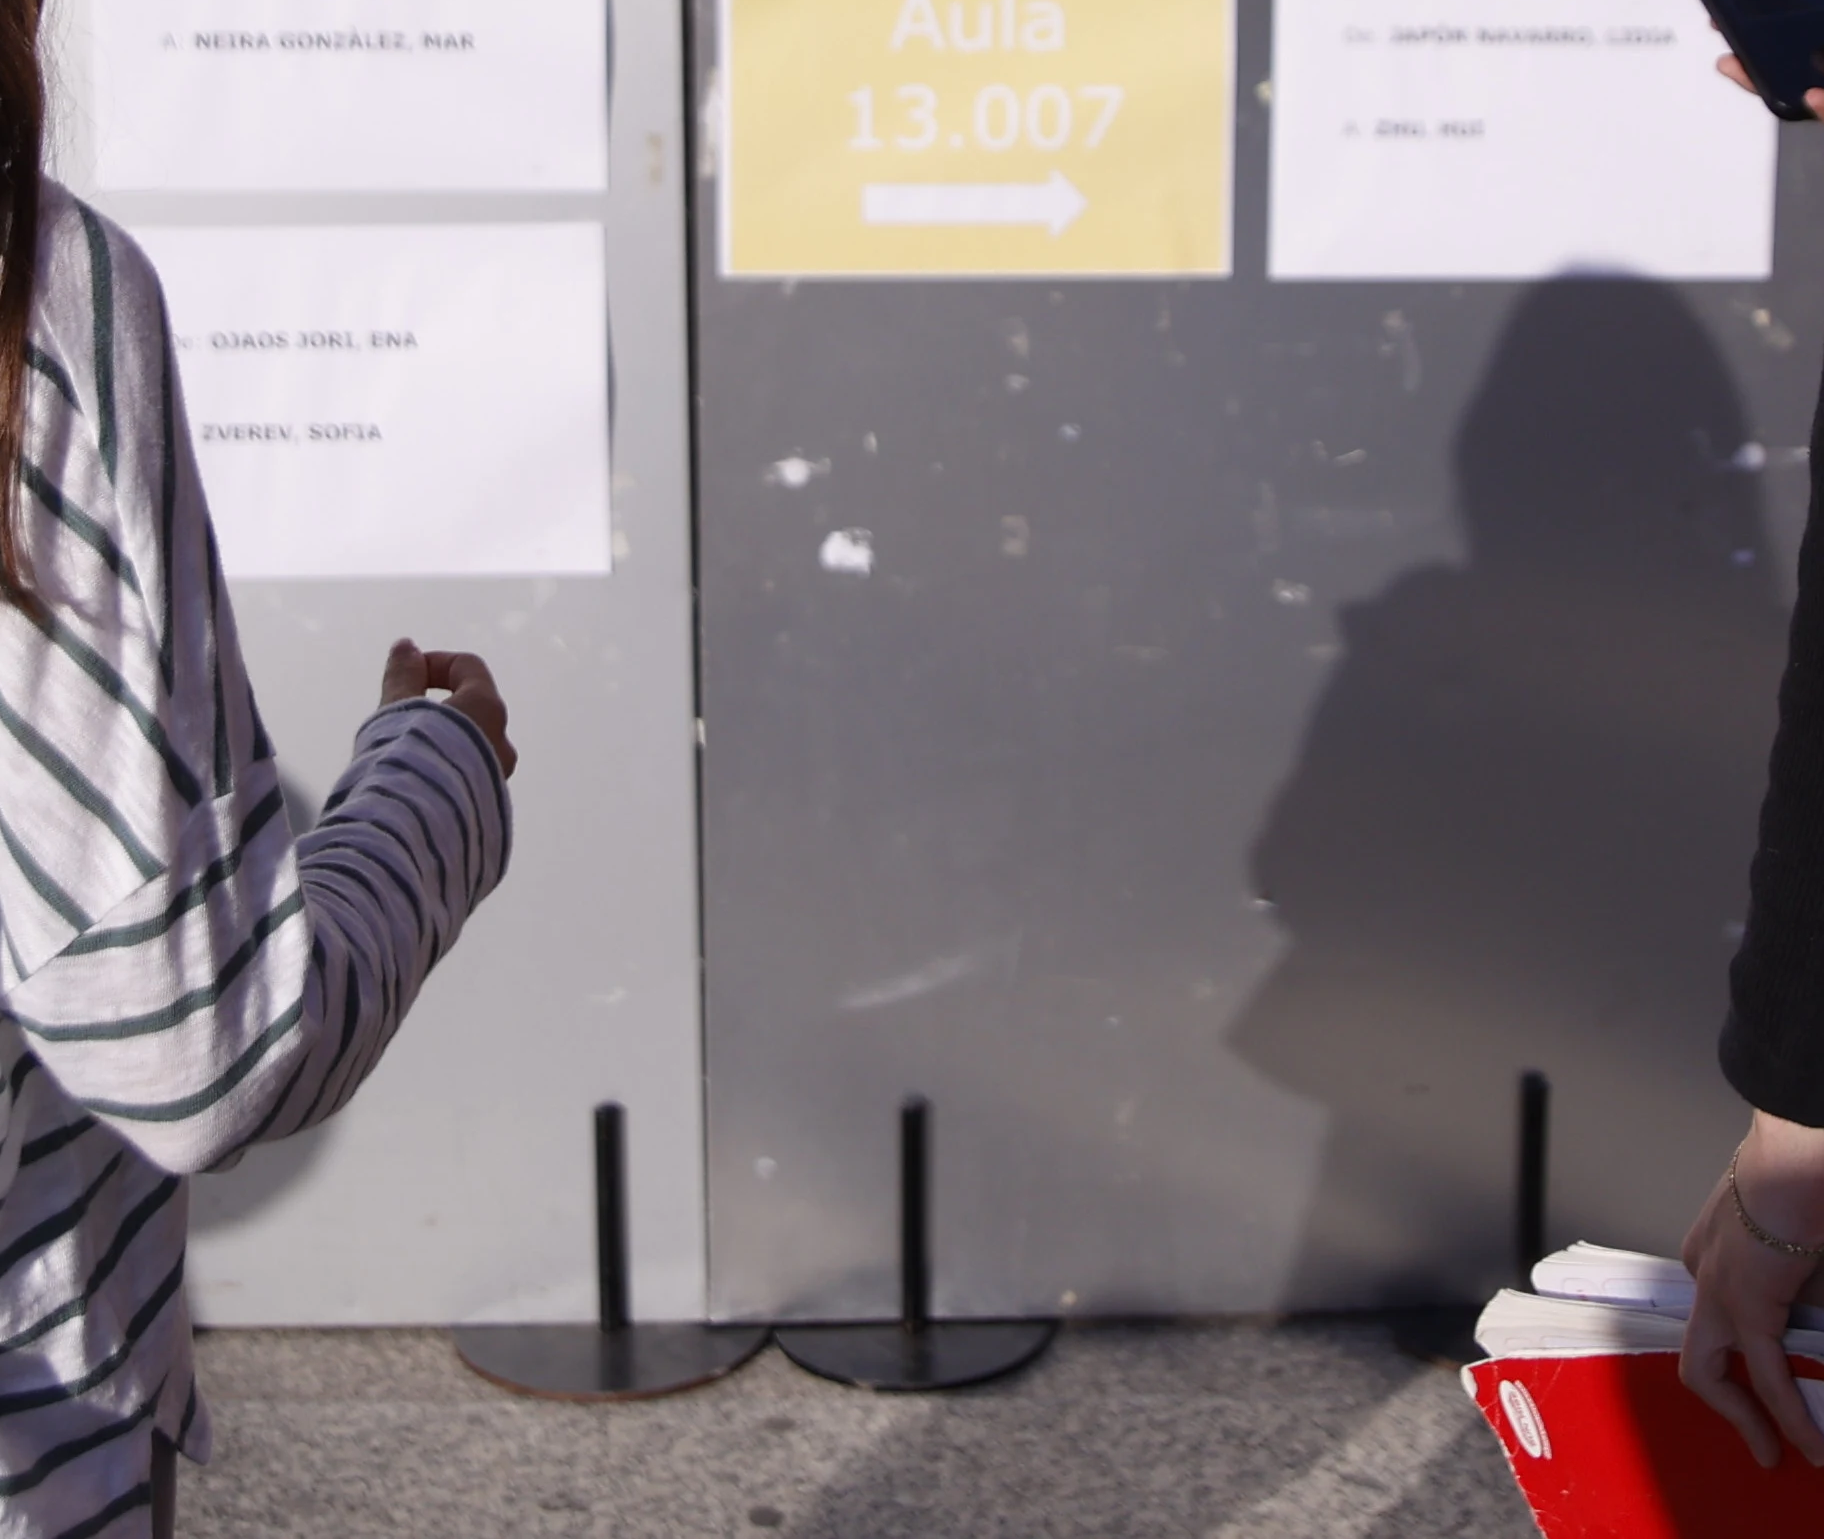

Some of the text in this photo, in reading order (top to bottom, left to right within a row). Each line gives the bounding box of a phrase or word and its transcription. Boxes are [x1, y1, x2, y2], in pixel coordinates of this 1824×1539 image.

[422, 31, 477, 51] MAR
[848, 83, 1124, 153] 13.007
[370, 331, 418, 349] ENA
